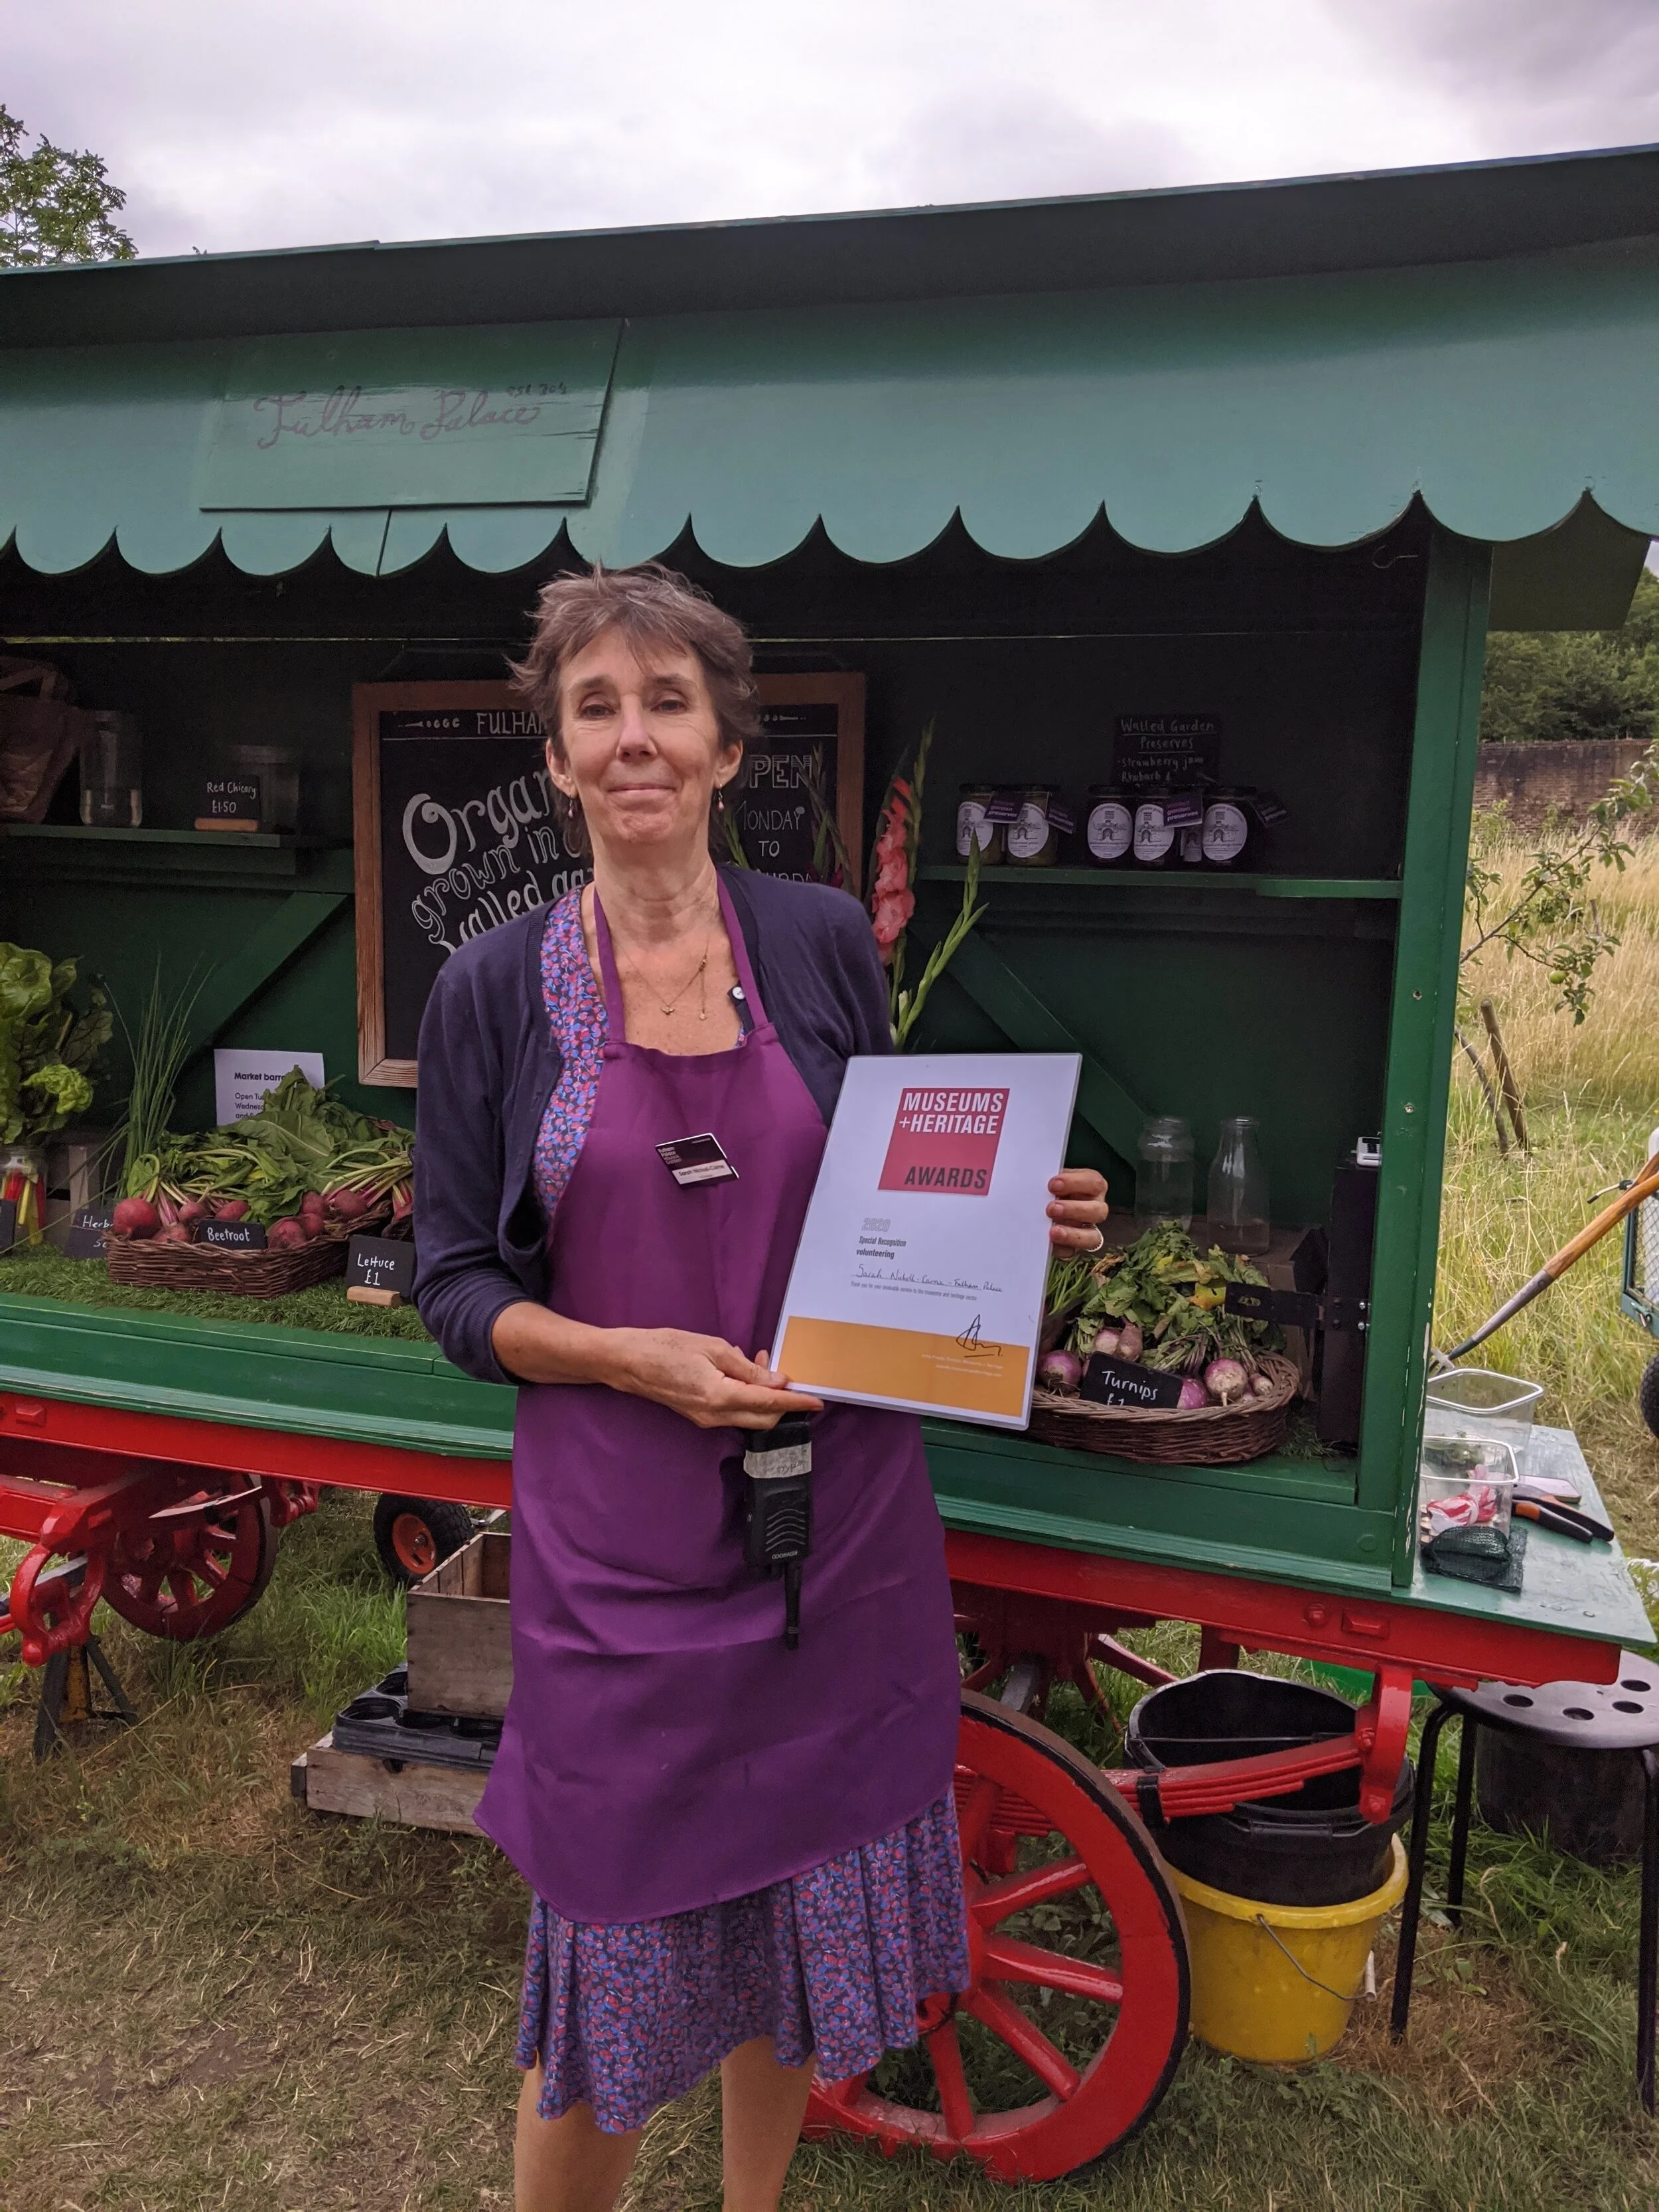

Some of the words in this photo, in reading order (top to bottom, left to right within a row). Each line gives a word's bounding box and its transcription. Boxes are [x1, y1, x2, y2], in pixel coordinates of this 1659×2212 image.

[253, 384, 415, 449] Fulham
[419, 388, 541, 440] Palace
[476, 711, 543, 735] FULHA
[1121, 717, 1165, 733] Walled
[1171, 719, 1214, 733] Garden
[1140, 735, 1194, 750] Preserves
[207, 782, 224, 794] Red
[758, 841, 780, 857] TO
[411, 844, 520, 944] grown
[524, 826, 559, 864] in
[234, 1072, 262, 1080] Market
[234, 1092, 253, 1101] Open
[902, 1092, 1004, 1113] MUSEUMS
[904, 1166, 987, 1189] AWARDS
[861, 1217, 891, 1232] 2020
[207, 1228, 250, 1242] Beetroot
[859, 1236, 877, 1245] Special
[878, 1237, 906, 1247] Recognition
[357, 1253, 395, 1270] Lettuce
[856, 1248, 895, 1260] volunteering
[364, 1269, 380, 1286] £1
[1102, 1371, 1158, 1400] Turnips
